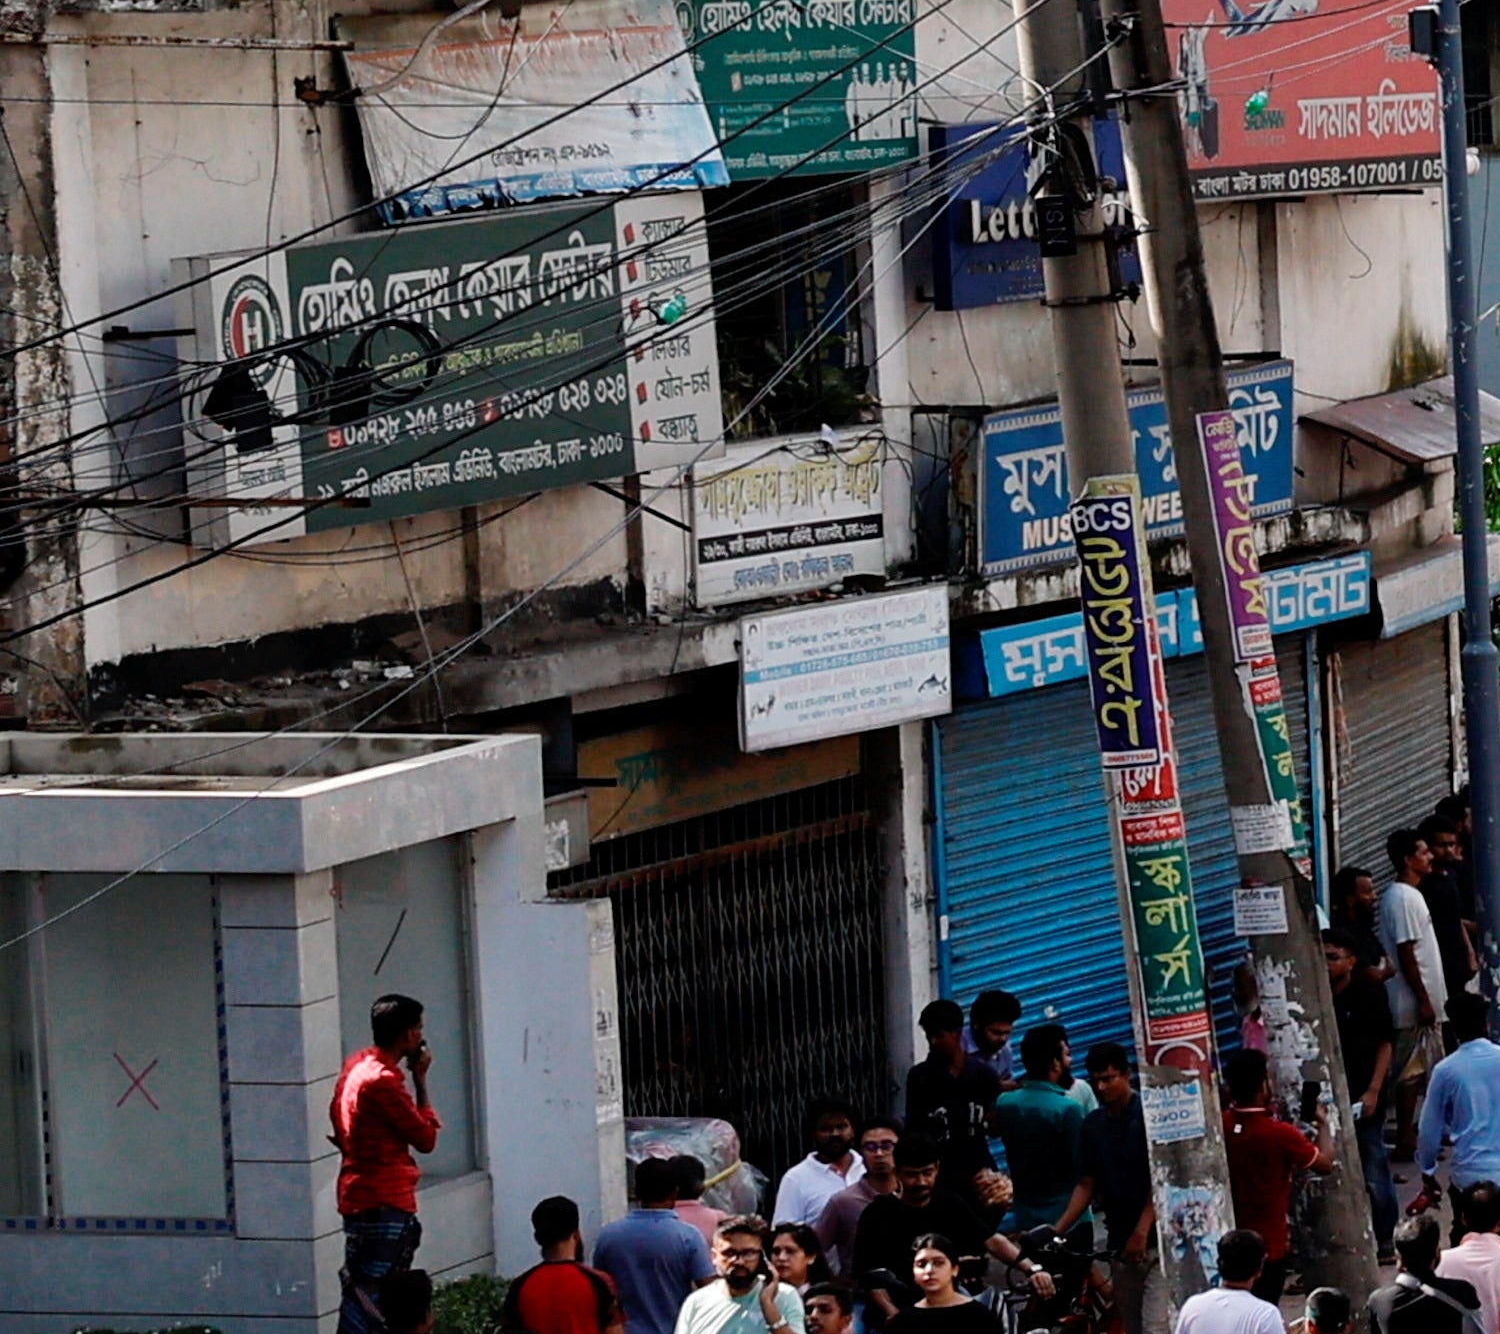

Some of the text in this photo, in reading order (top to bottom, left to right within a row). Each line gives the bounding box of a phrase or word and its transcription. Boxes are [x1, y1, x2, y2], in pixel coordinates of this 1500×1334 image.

[1297, 78, 1436, 141] সাদমান হলিডেজ
[1198, 173, 1229, 197] বাংলা
[1231, 171, 1258, 191] মটর
[1259, 170, 1286, 190] ঢাকা
[1287, 163, 1407, 191] 01958-107001
[1072, 501, 1132, 535] BCS
